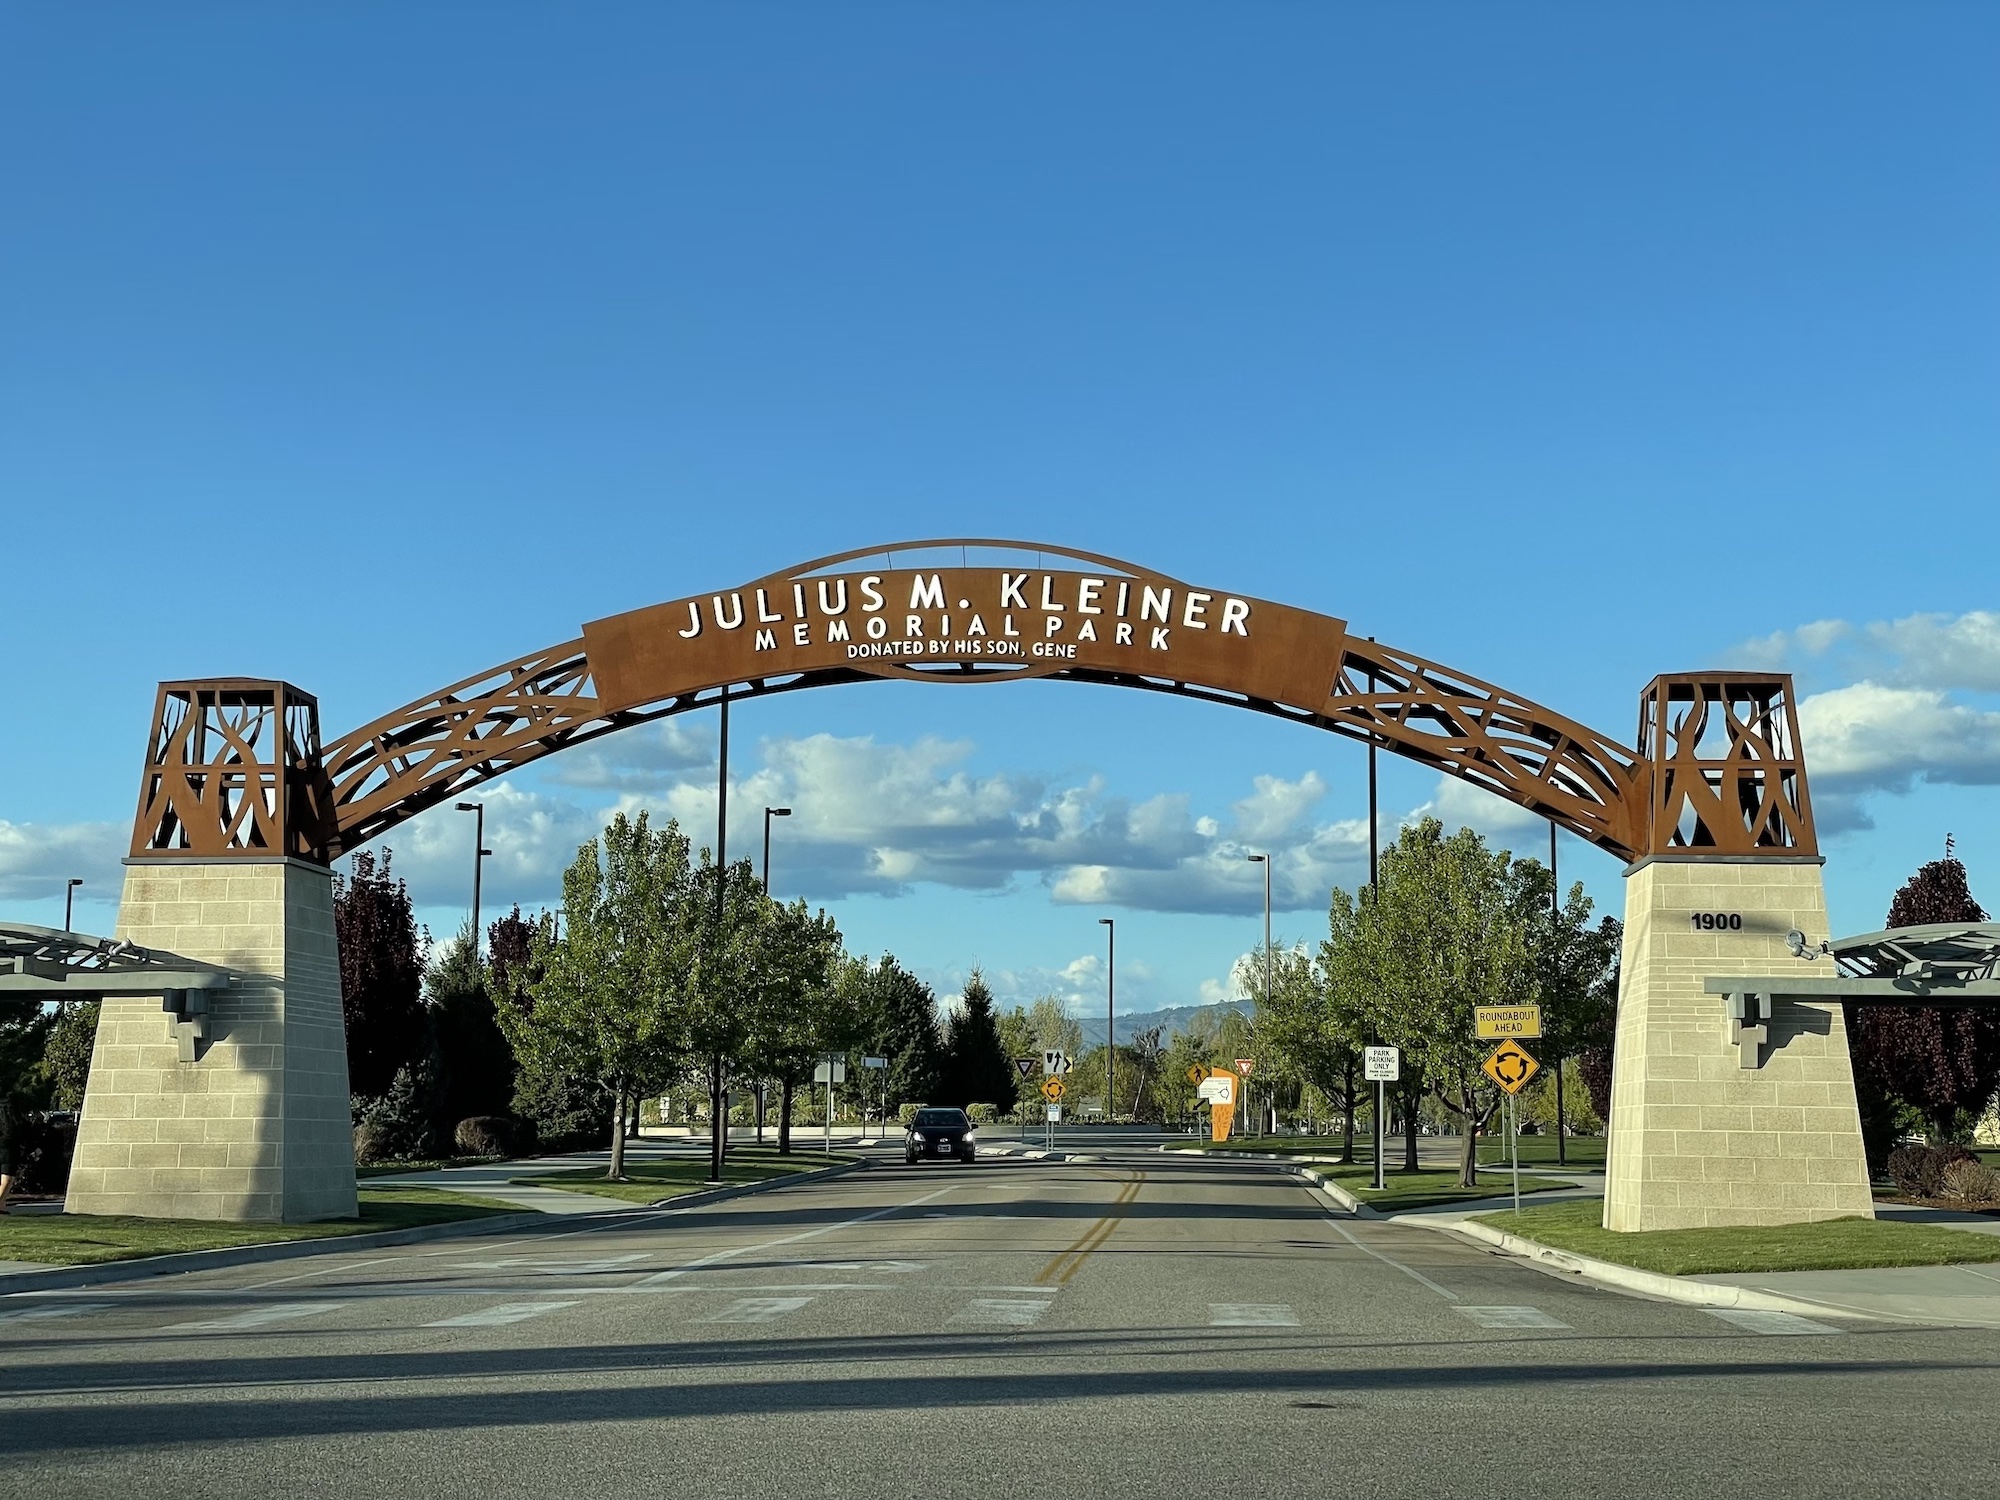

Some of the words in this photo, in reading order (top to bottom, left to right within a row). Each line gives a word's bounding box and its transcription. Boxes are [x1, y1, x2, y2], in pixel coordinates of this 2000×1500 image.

[678, 576, 885, 638] JULIUS
[909, 573, 970, 609] M.
[1000, 573, 1250, 637] KLEINER
[755, 614, 1020, 651] MEMORIAL
[1046, 615, 1170, 651] PARK
[847, 640, 924, 659] DONATED
[929, 640, 950, 654] BY
[954, 640, 981, 654] HIS
[986, 640, 1026, 657] SON,
[1032, 641, 1077, 659] GENE
[1691, 913, 1742, 930] 1900
[1479, 1011, 1535, 1022] ROUNDABOUT
[1494, 1022, 1523, 1032] AHEAD
